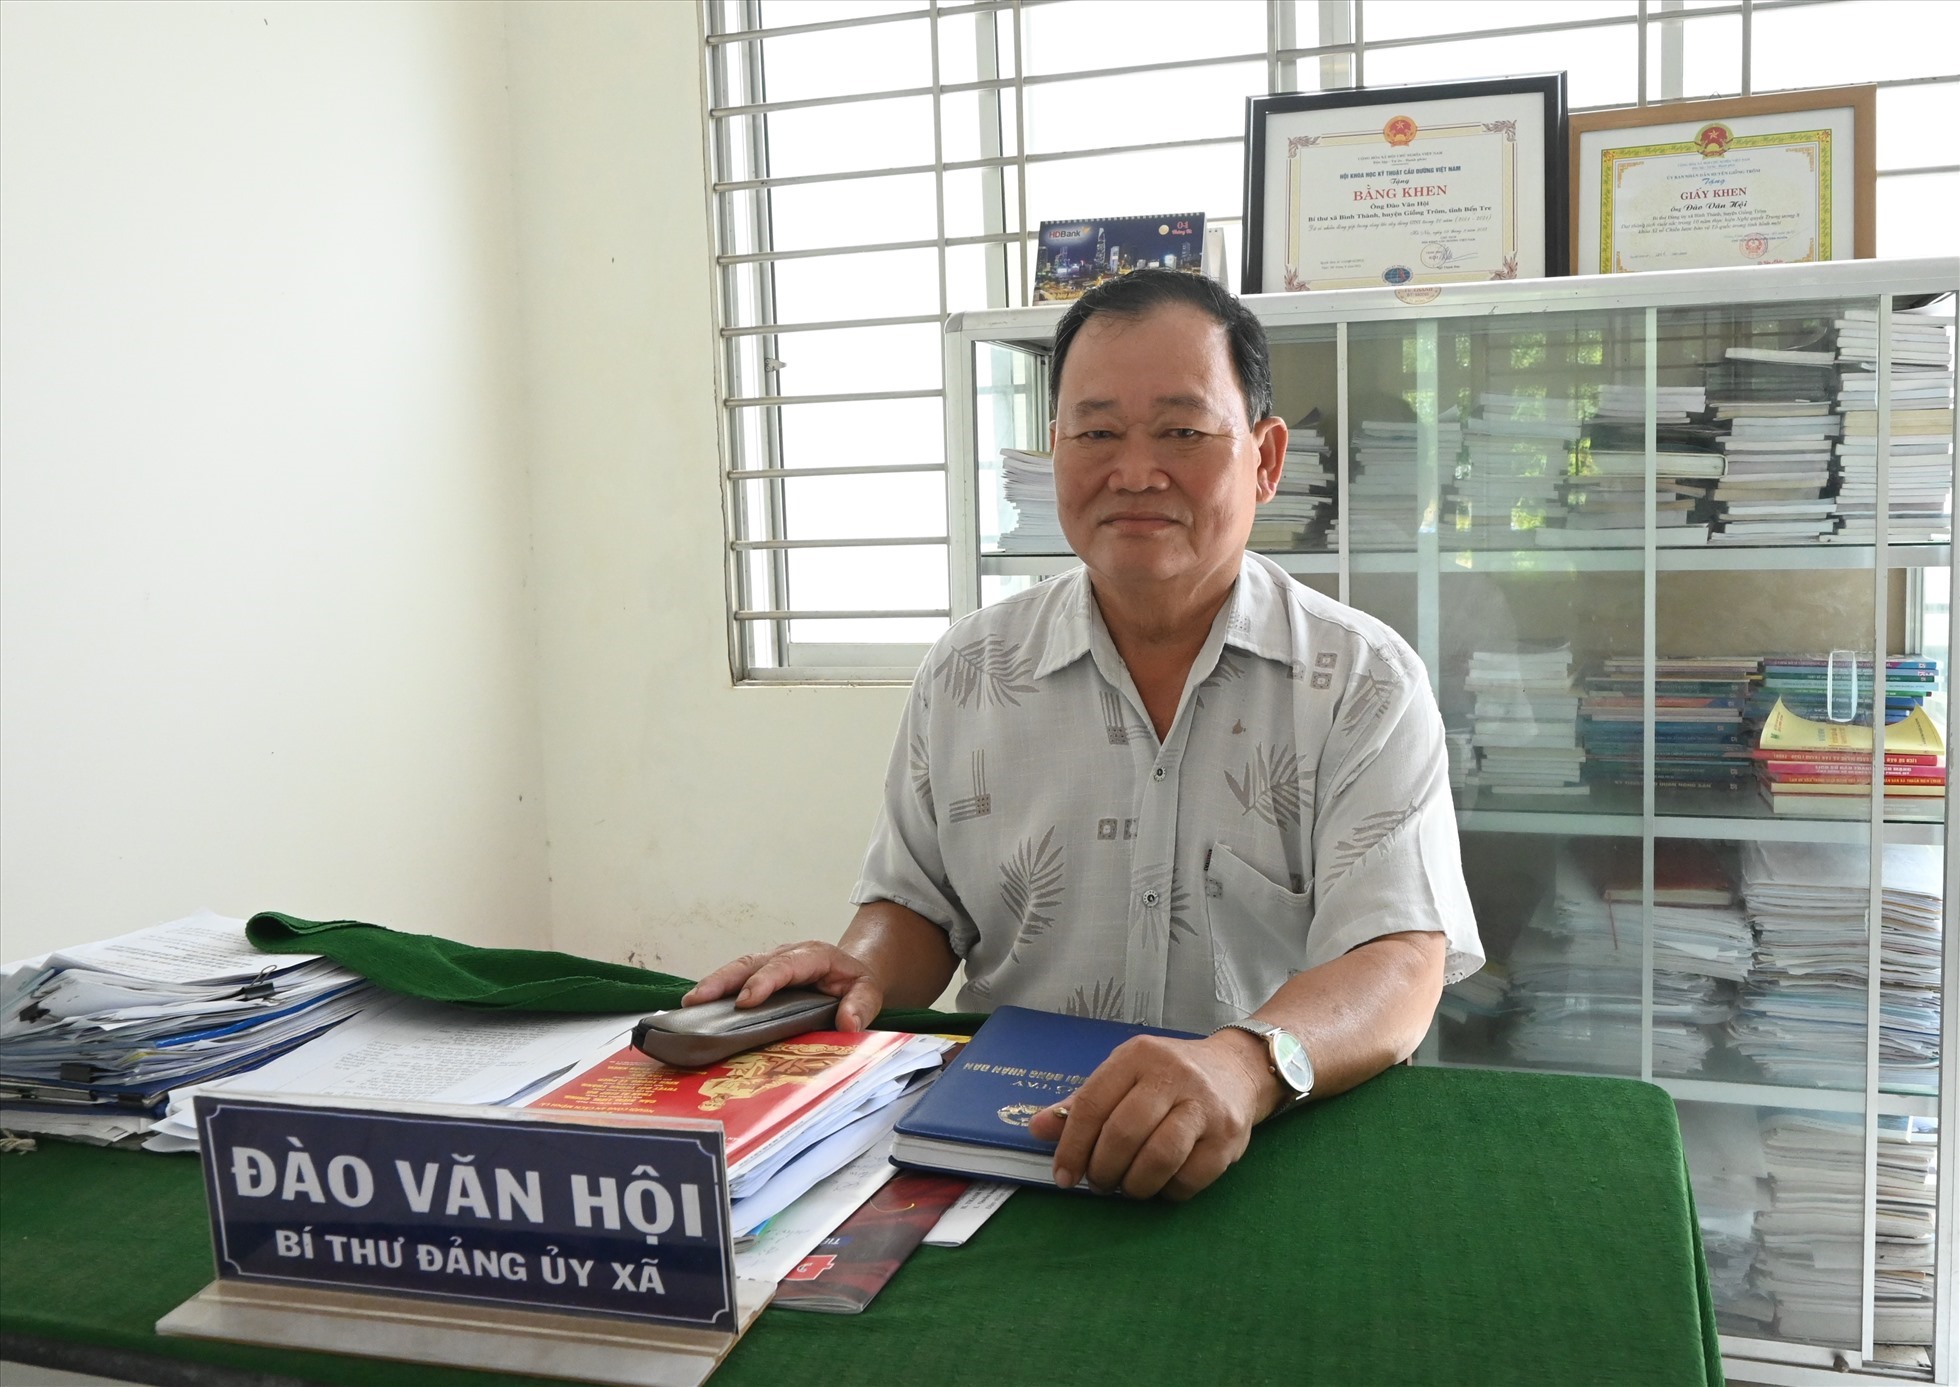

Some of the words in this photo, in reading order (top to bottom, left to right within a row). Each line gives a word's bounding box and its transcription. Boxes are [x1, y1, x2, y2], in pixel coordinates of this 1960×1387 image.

[1402, 184, 1448, 198] KHEN
[1680, 187, 1710, 201] GIẤY
[1713, 186, 1747, 198] KHEN
[1729, 200, 1748, 209] Hội
[1048, 230, 1081, 239] HDBank
[963, 1062, 991, 1073] DÂN
[991, 1065, 1028, 1077] NHÂN
[1028, 1070, 1064, 1081] ĐỒNG
[1010, 1080, 1051, 1091] TAY
[231, 1136, 374, 1208] ĐÀO
[395, 1153, 544, 1224] VĂN
[570, 1164, 703, 1245] HỘI
[275, 1226, 314, 1260] BÍ
[324, 1236, 405, 1269] THƯ
[416, 1236, 528, 1282] ĐẢNG
[540, 1245, 595, 1287] ỦY
[610, 1258, 666, 1295] XÃ
